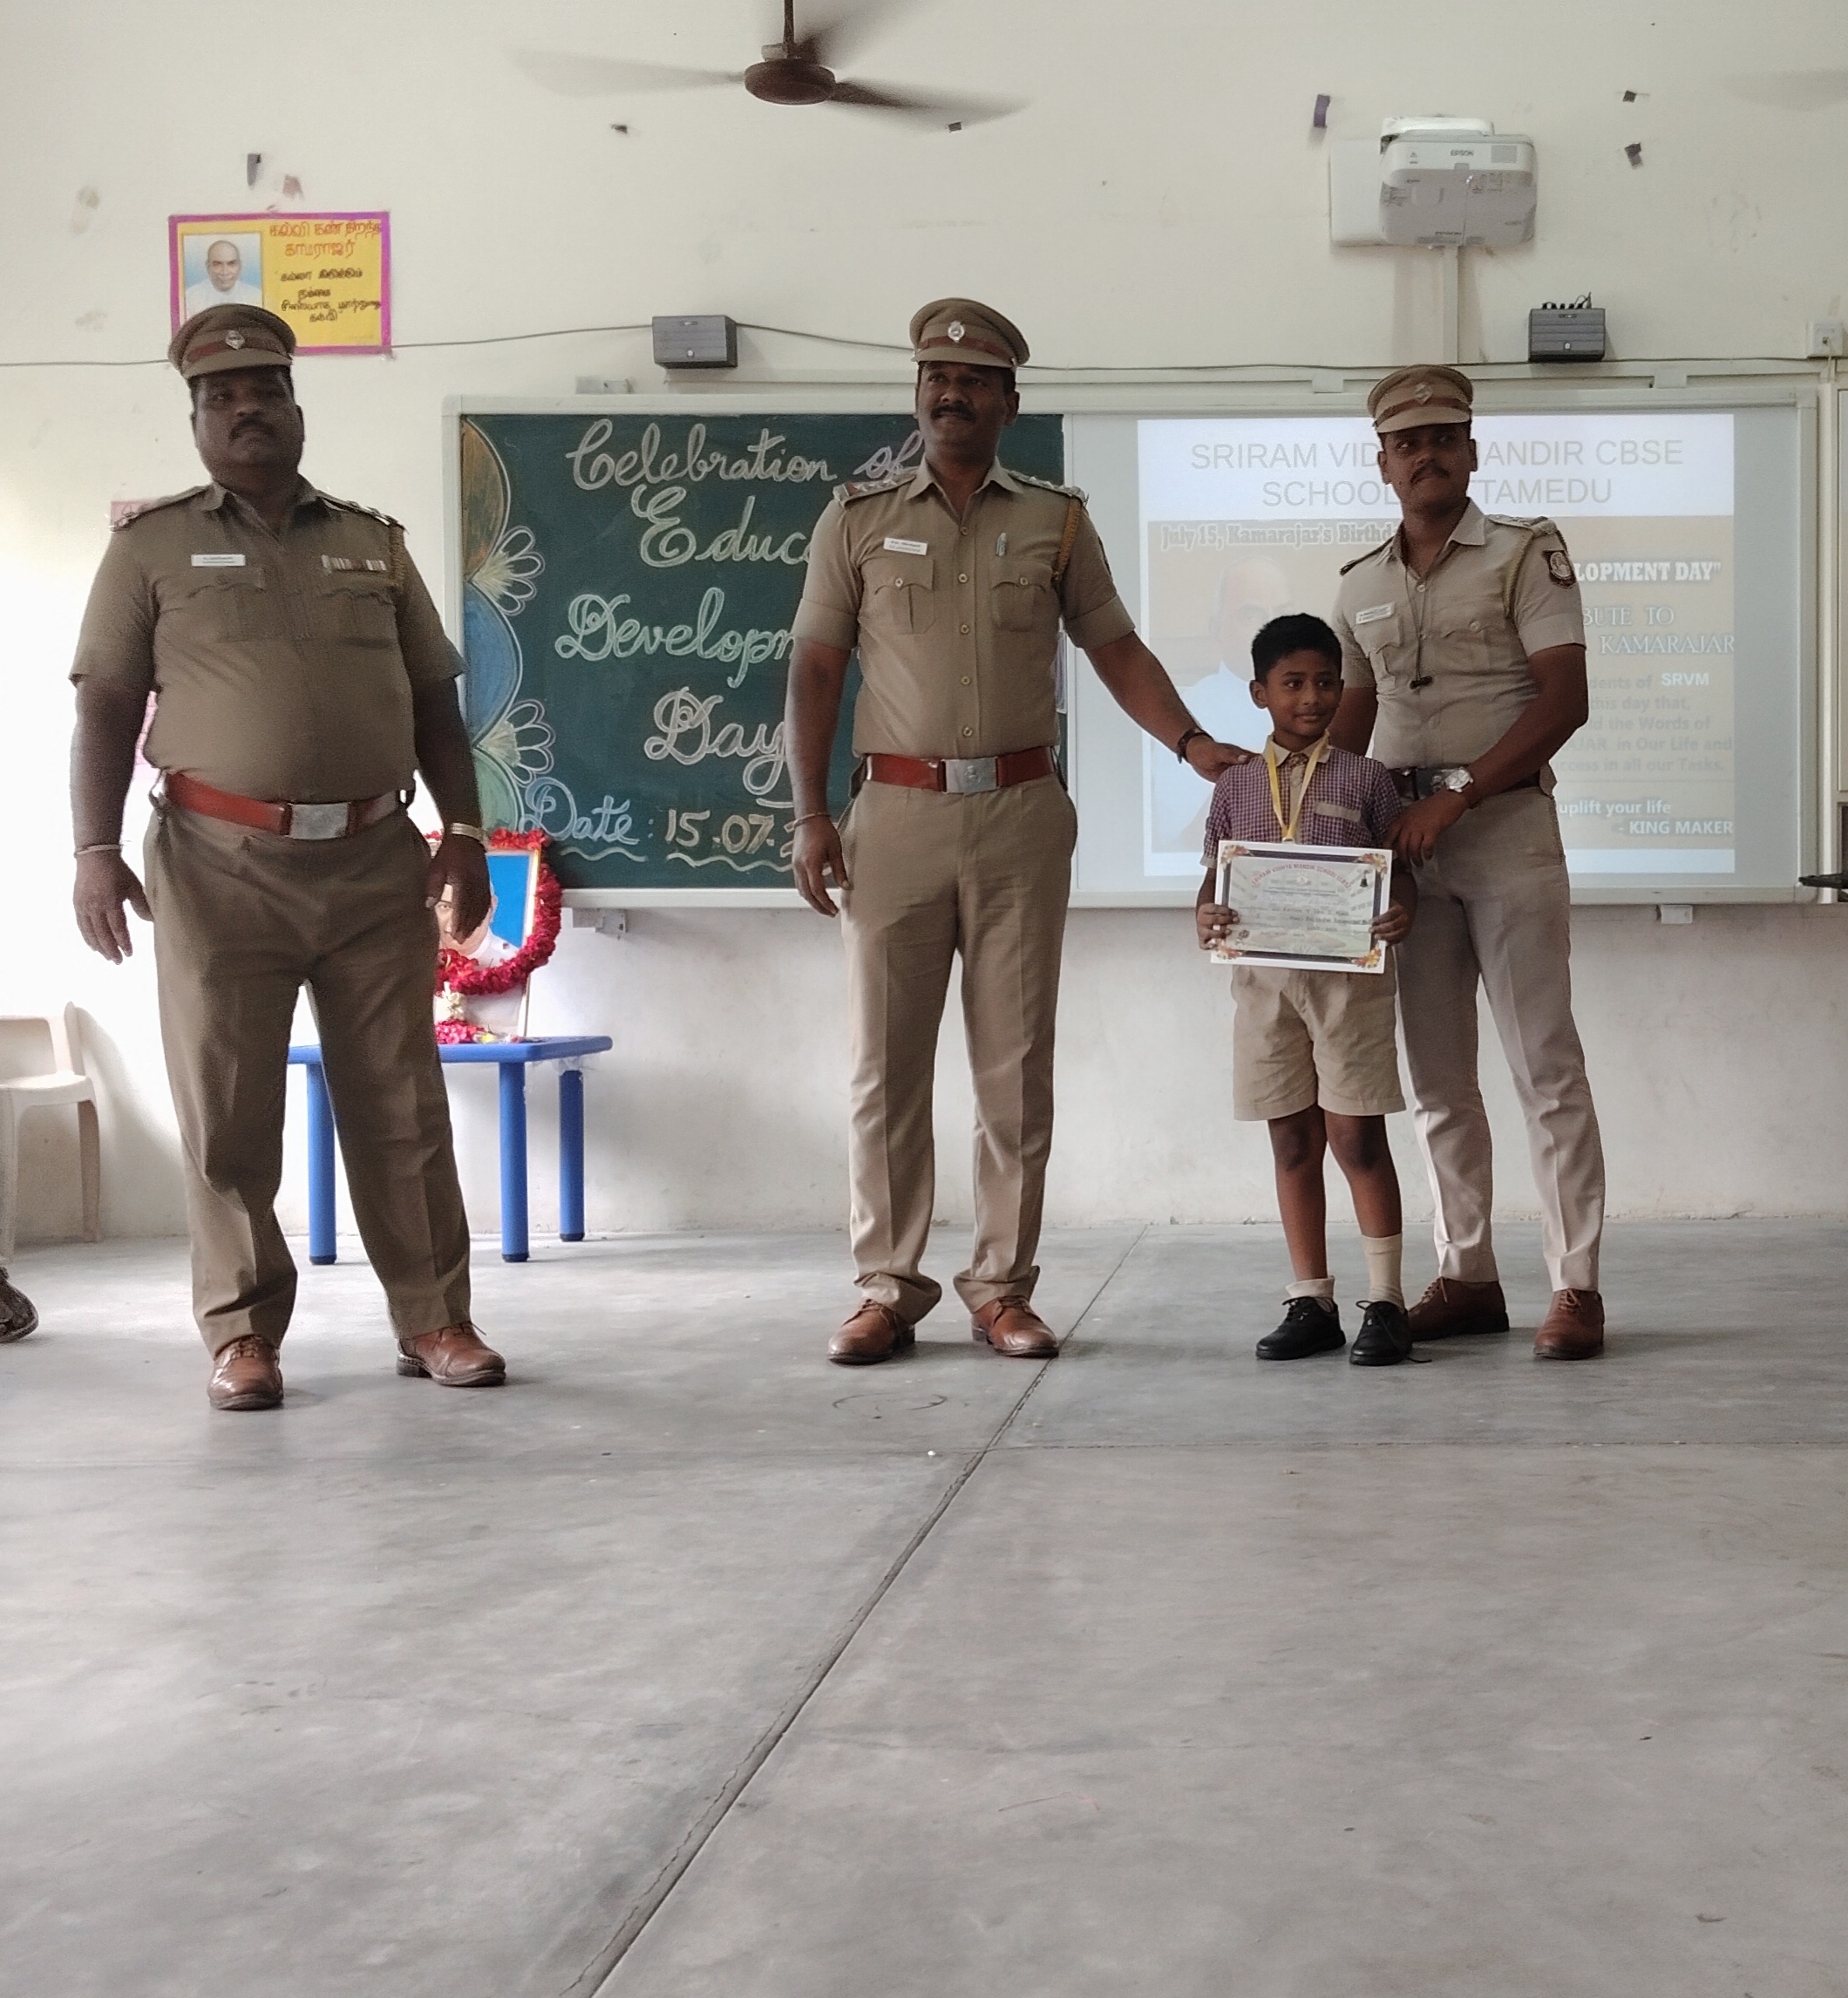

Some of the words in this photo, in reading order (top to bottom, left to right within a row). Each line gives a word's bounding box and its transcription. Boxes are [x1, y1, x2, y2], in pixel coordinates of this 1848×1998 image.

[566, 418, 838, 490] Celebration
[853, 430, 924, 480] of
[1191, 443, 1318, 469] SRIRAM
[1328, 442, 1383, 468] VID
[1475, 439, 1584, 466] ANDIR
[1595, 438, 1683, 465] CBSE
[1262, 480, 1399, 507] SCHOOL
[1470, 478, 1612, 505] TAMEDU
[631, 485, 812, 567] Educ
[1162, 525, 1195, 551] July
[1199, 525, 1224, 550] 15,
[1226, 524, 1334, 549] Kamarajar's
[1337, 524, 1397, 545] Birthd
[1573, 561, 1670, 582] LOPMENT
[1583, 607, 1632, 626] BUTE
[1645, 606, 1675, 626] TO
[1600, 635, 1735, 655] KAMARAJAR
[1589, 676, 1633, 690] dents
[1635, 676, 1654, 690] of
[1661, 672, 1710, 686] SRVM
[1622, 697, 1650, 713] day
[1639, 717, 1689, 731] Words
[643, 686, 786, 796] Day
[1635, 737, 1668, 751] Our
[1671, 737, 1698, 751] Life
[1702, 737, 1733, 751] and
[1622, 758, 1641, 771] all
[1646, 761, 1674, 771] our
[1559, 800, 1601, 817] uplift
[1606, 803, 1642, 818] your
[1647, 800, 1671, 814] life
[1628, 821, 1670, 834] KING
[1675, 821, 1734, 834] MAKER
